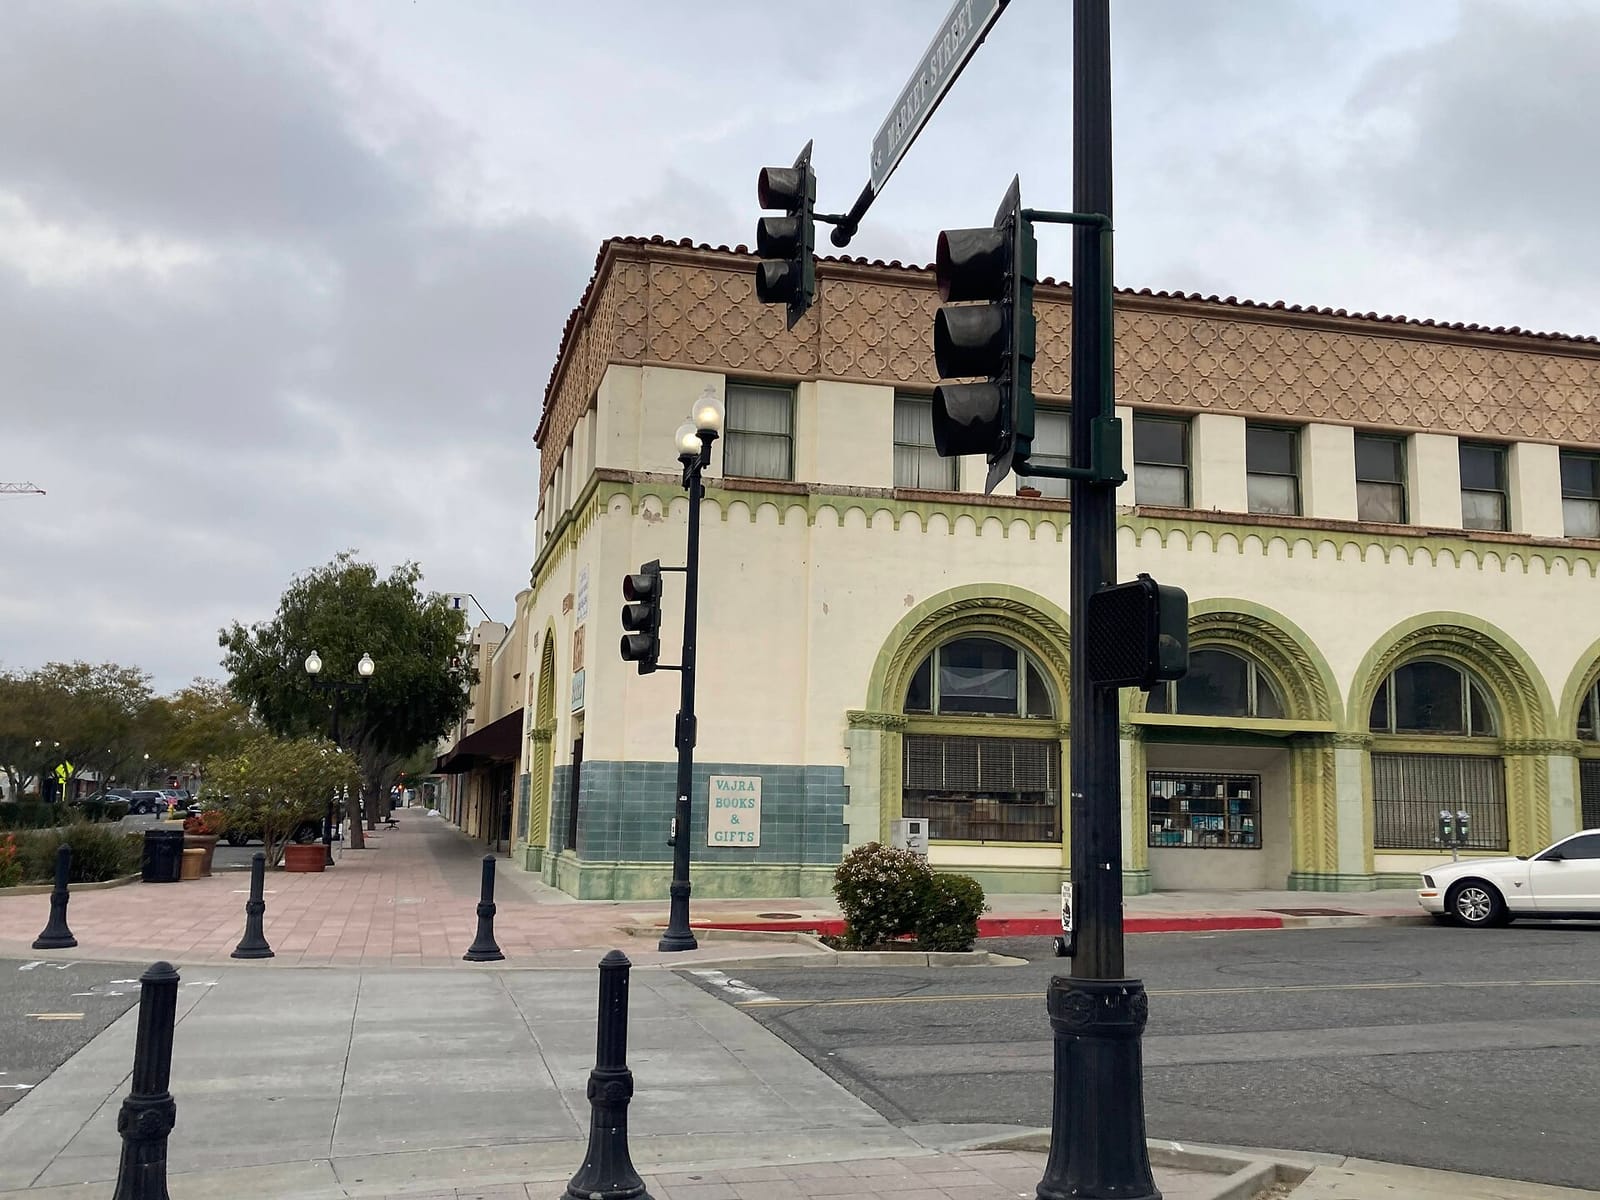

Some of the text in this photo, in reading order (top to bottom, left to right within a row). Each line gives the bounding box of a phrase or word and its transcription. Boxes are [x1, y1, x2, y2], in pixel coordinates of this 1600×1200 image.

[887, 0, 974, 157] MARKET STREET
[716, 780, 755, 791] VAJRA
[716, 798, 755, 808] BOOKS
[731, 814, 740, 825] &
[714, 831, 755, 842] GIFTS
